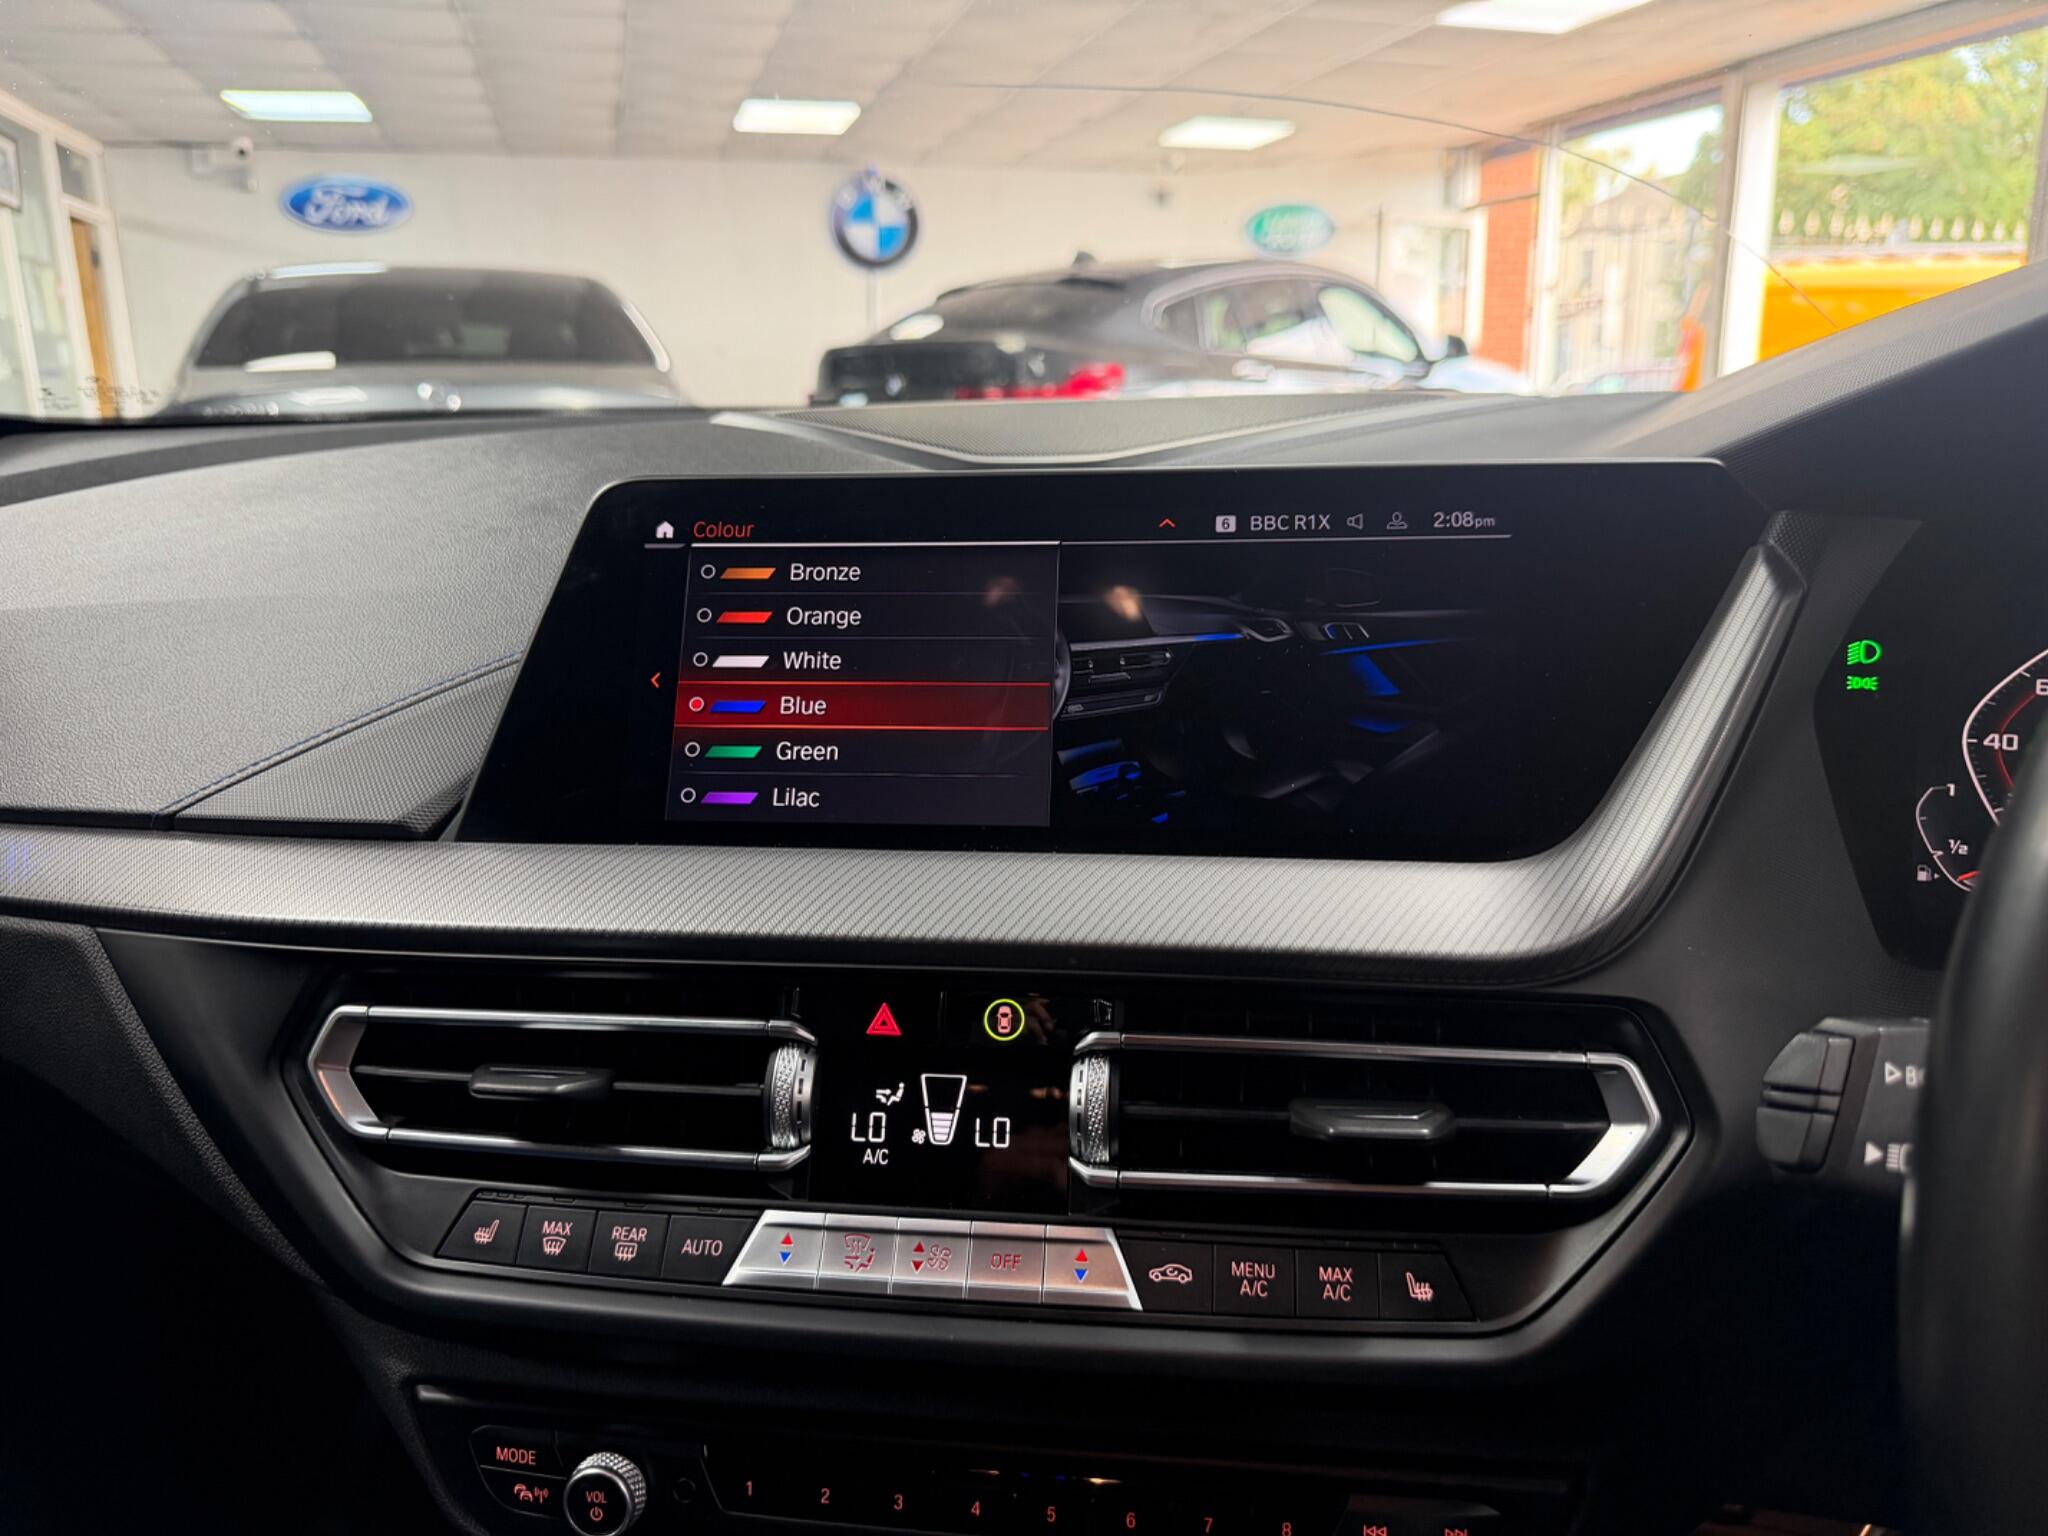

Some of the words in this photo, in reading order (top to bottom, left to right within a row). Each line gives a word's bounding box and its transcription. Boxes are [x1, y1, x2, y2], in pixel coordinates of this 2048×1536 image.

[303, 186, 390, 226] Ford
[693, 520, 754, 539] Colour
[1250, 514, 1289, 531] BBC
[1294, 514, 1331, 530] R1X
[790, 562, 861, 582] Bronze
[786, 606, 862, 629] Orange
[783, 650, 842, 670] White
[779, 695, 827, 715] Blue
[776, 741, 839, 761] Green
[1983, 733, 2019, 751] 40
[772, 787, 820, 808] Lilac
[1946, 783, 1956, 797] 1
[862, 1148, 889, 1165] A/C
[542, 1220, 573, 1236] MAX
[611, 1226, 648, 1243] REAR
[681, 1238, 723, 1257] AUTO
[991, 1254, 1021, 1271] OFF
[1231, 1261, 1276, 1279] MENU
[1319, 1266, 1353, 1282] MAX
[1239, 1279, 1268, 1297] A/C
[1323, 1283, 1351, 1302] A/C
[495, 1446, 536, 1465] MODE
[585, 1490, 607, 1504] VOL
[746, 1480, 753, 1496] 1
[820, 1487, 830, 1505] 2
[893, 1493, 904, 1511] 3
[970, 1501, 981, 1517] 4
[1046, 1505, 1057, 1523] 5
[1125, 1511, 1137, 1529] 6
[1204, 1516, 1214, 1533] 7
[1281, 1522, 1292, 1536] 8
